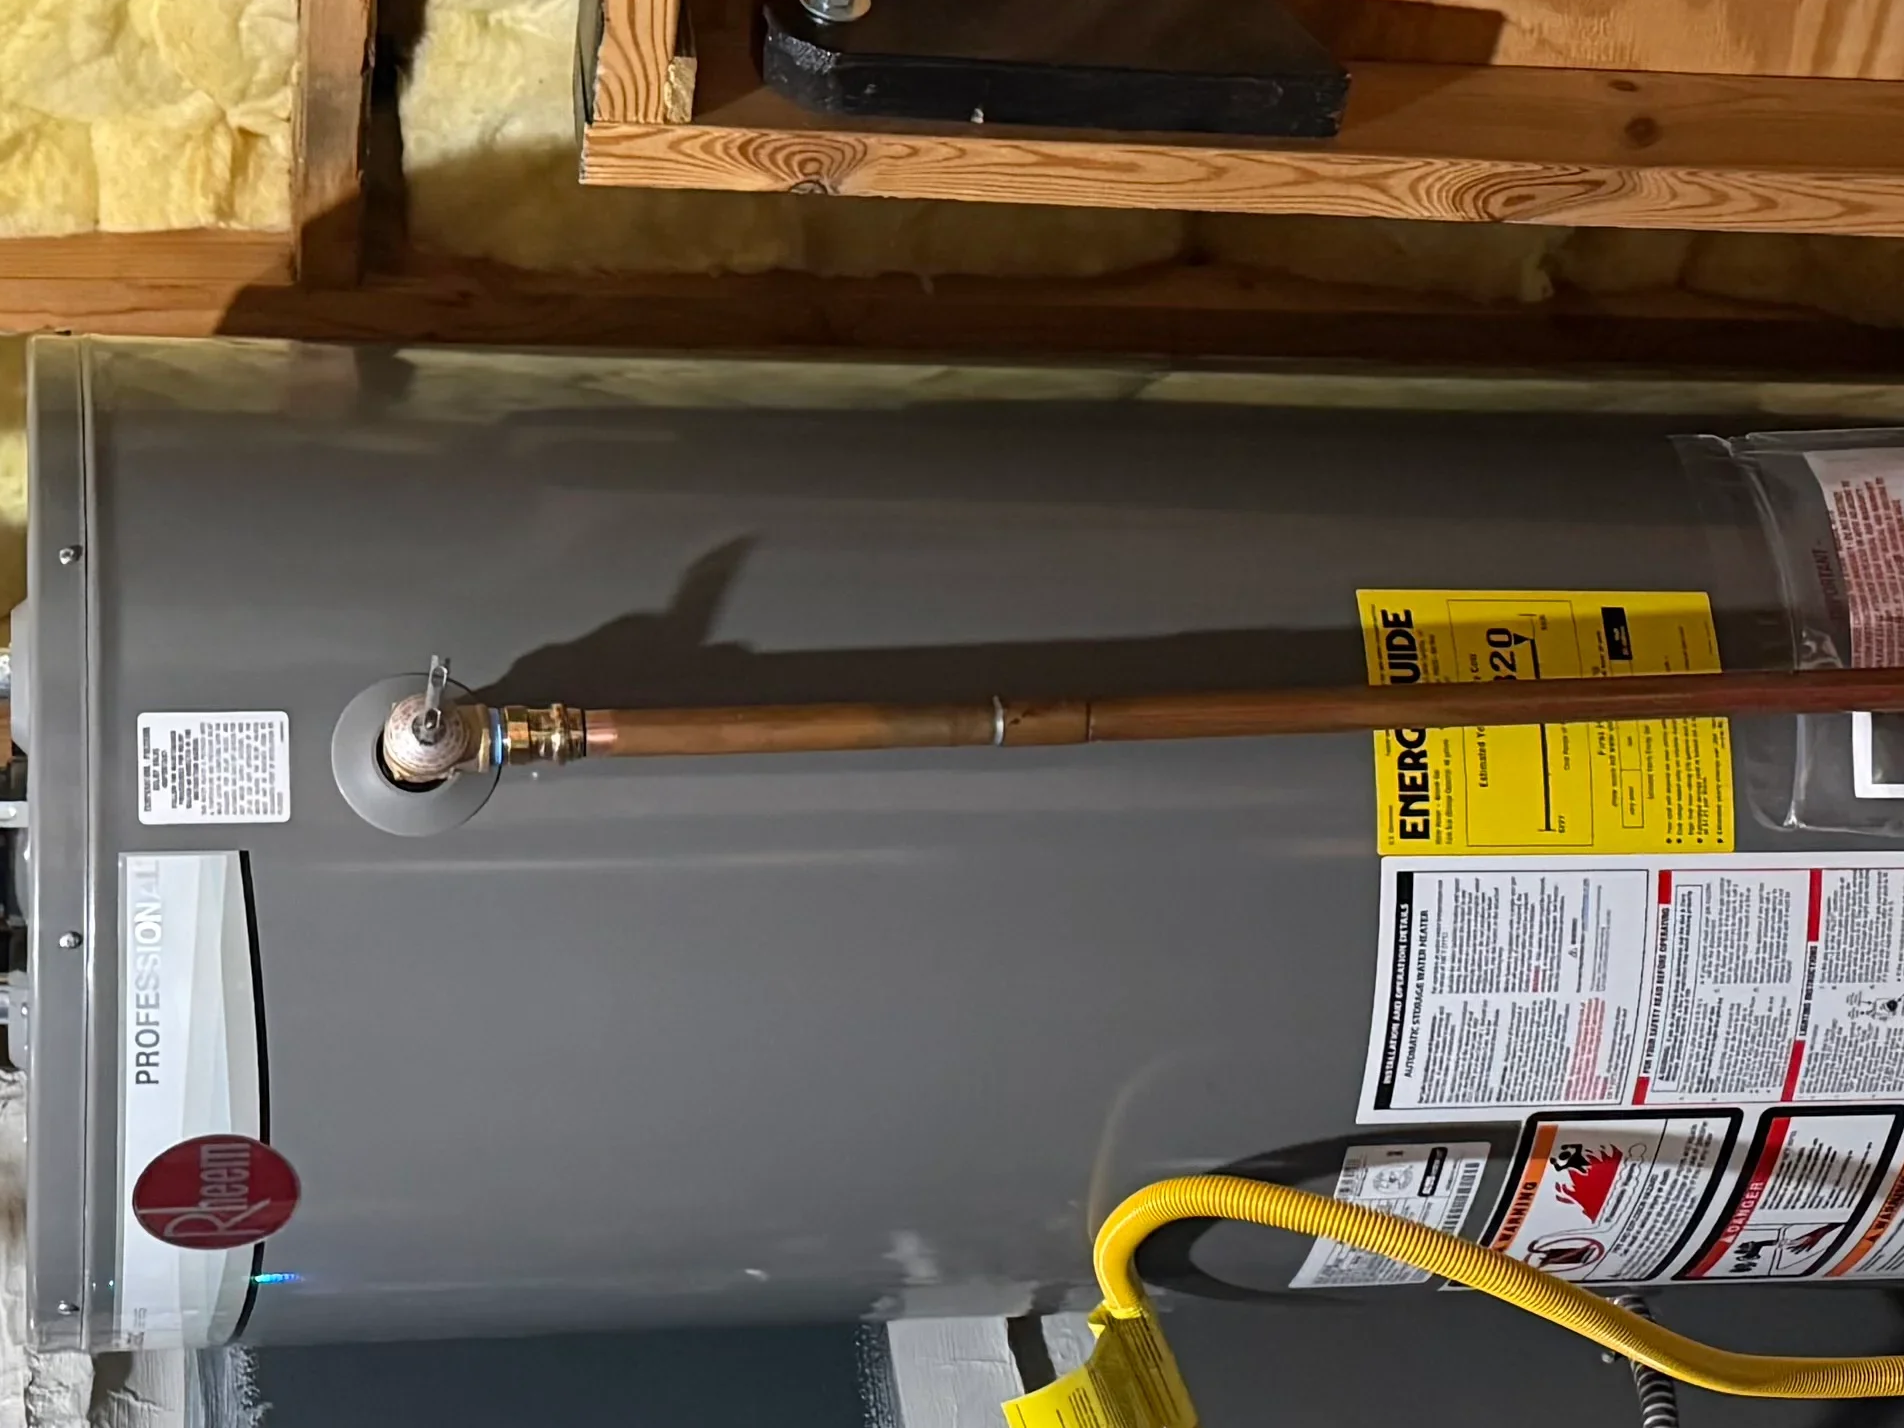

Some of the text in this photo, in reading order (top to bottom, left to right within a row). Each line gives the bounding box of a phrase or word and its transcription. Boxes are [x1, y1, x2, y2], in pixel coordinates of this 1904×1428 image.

[1476, 741, 1489, 788] Estimated
[1398, 903, 1409, 942] DETAILS
[1404, 909, 1429, 1078] AUTOMATIC STORAGE WATER HEATER
[137, 1143, 270, 1238] Rheem
[1499, 1181, 1537, 1243] WARNING
[1726, 1181, 1764, 1233] DANGER
